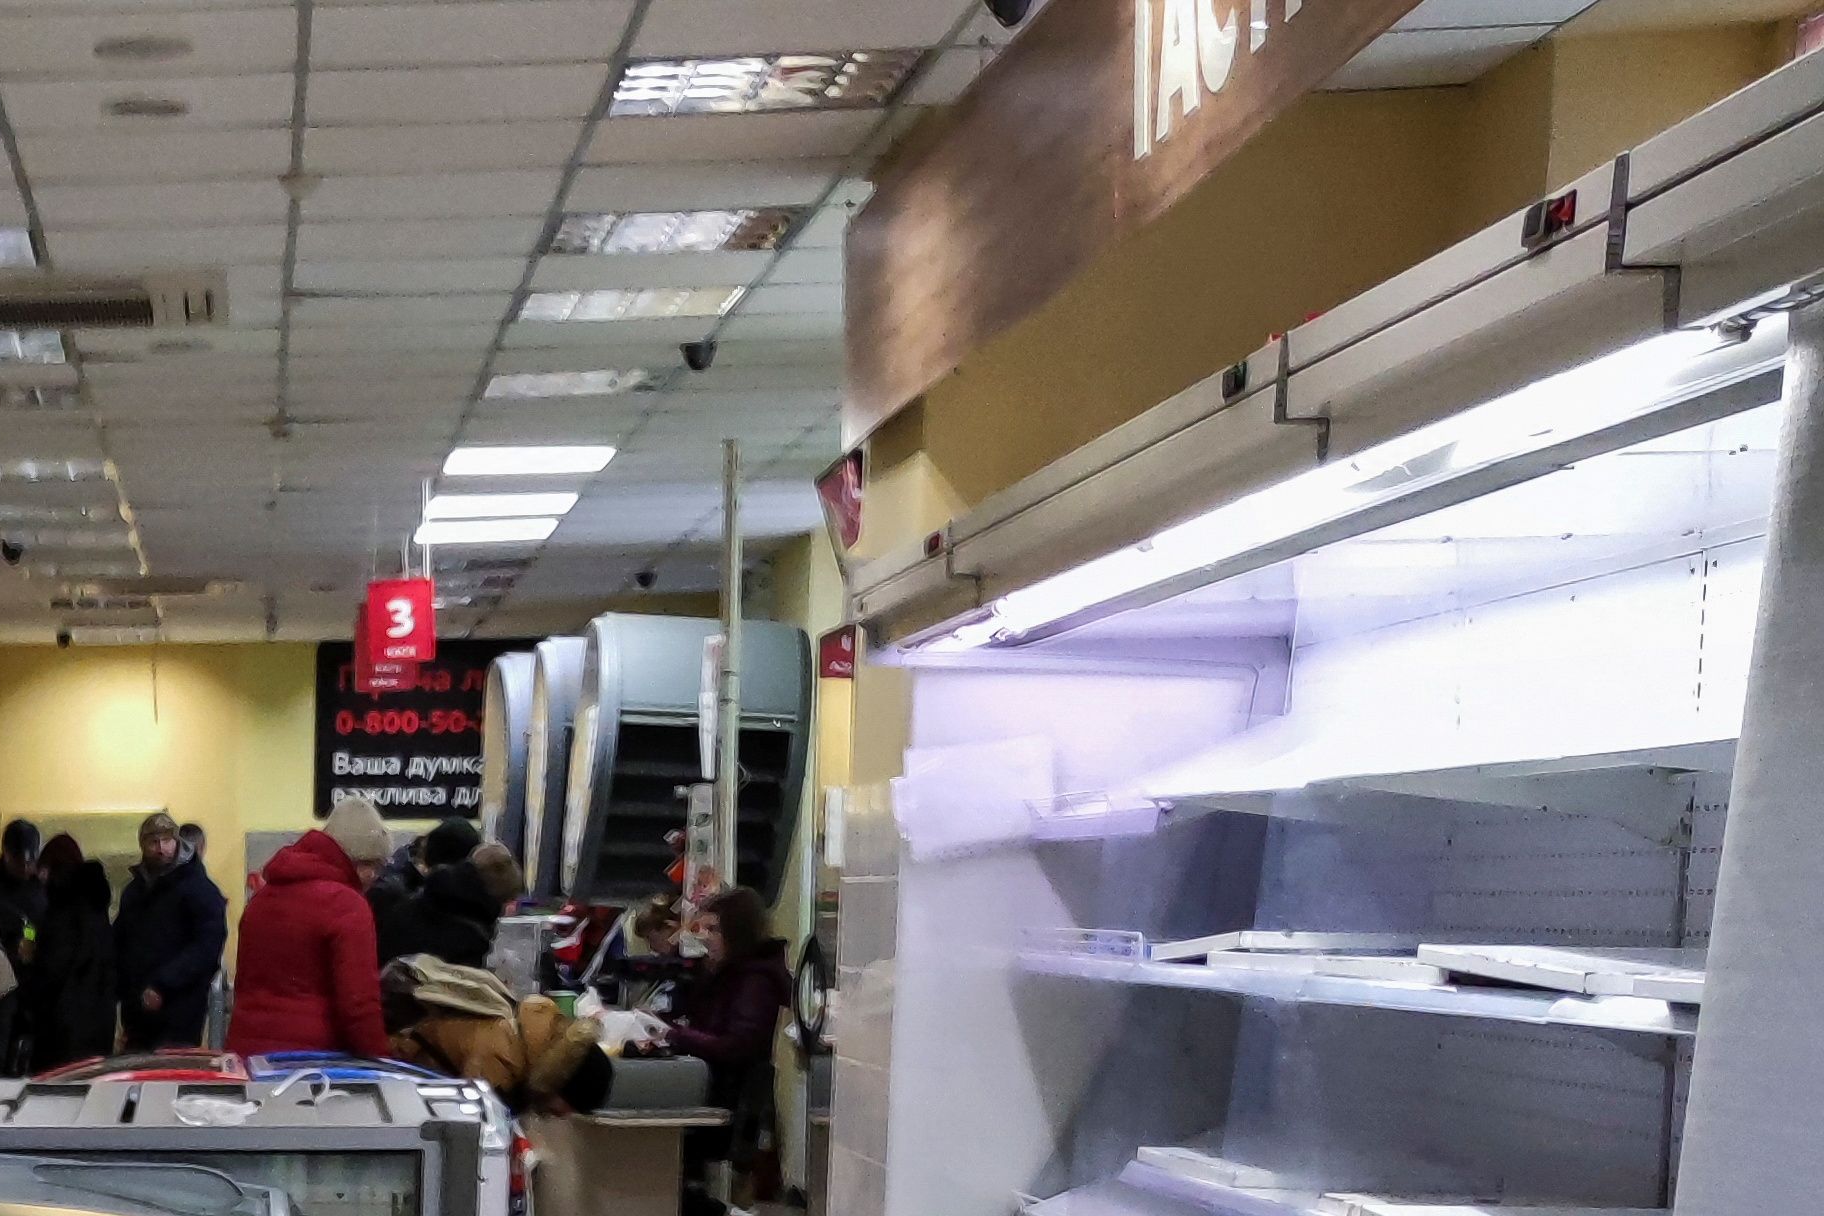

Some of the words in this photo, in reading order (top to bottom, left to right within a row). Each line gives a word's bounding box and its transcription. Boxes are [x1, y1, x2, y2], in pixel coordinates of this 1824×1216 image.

[384, 597, 416, 640] 3
[336, 710, 484, 736] 0-800-50-
[332, 752, 401, 776] Ваша
